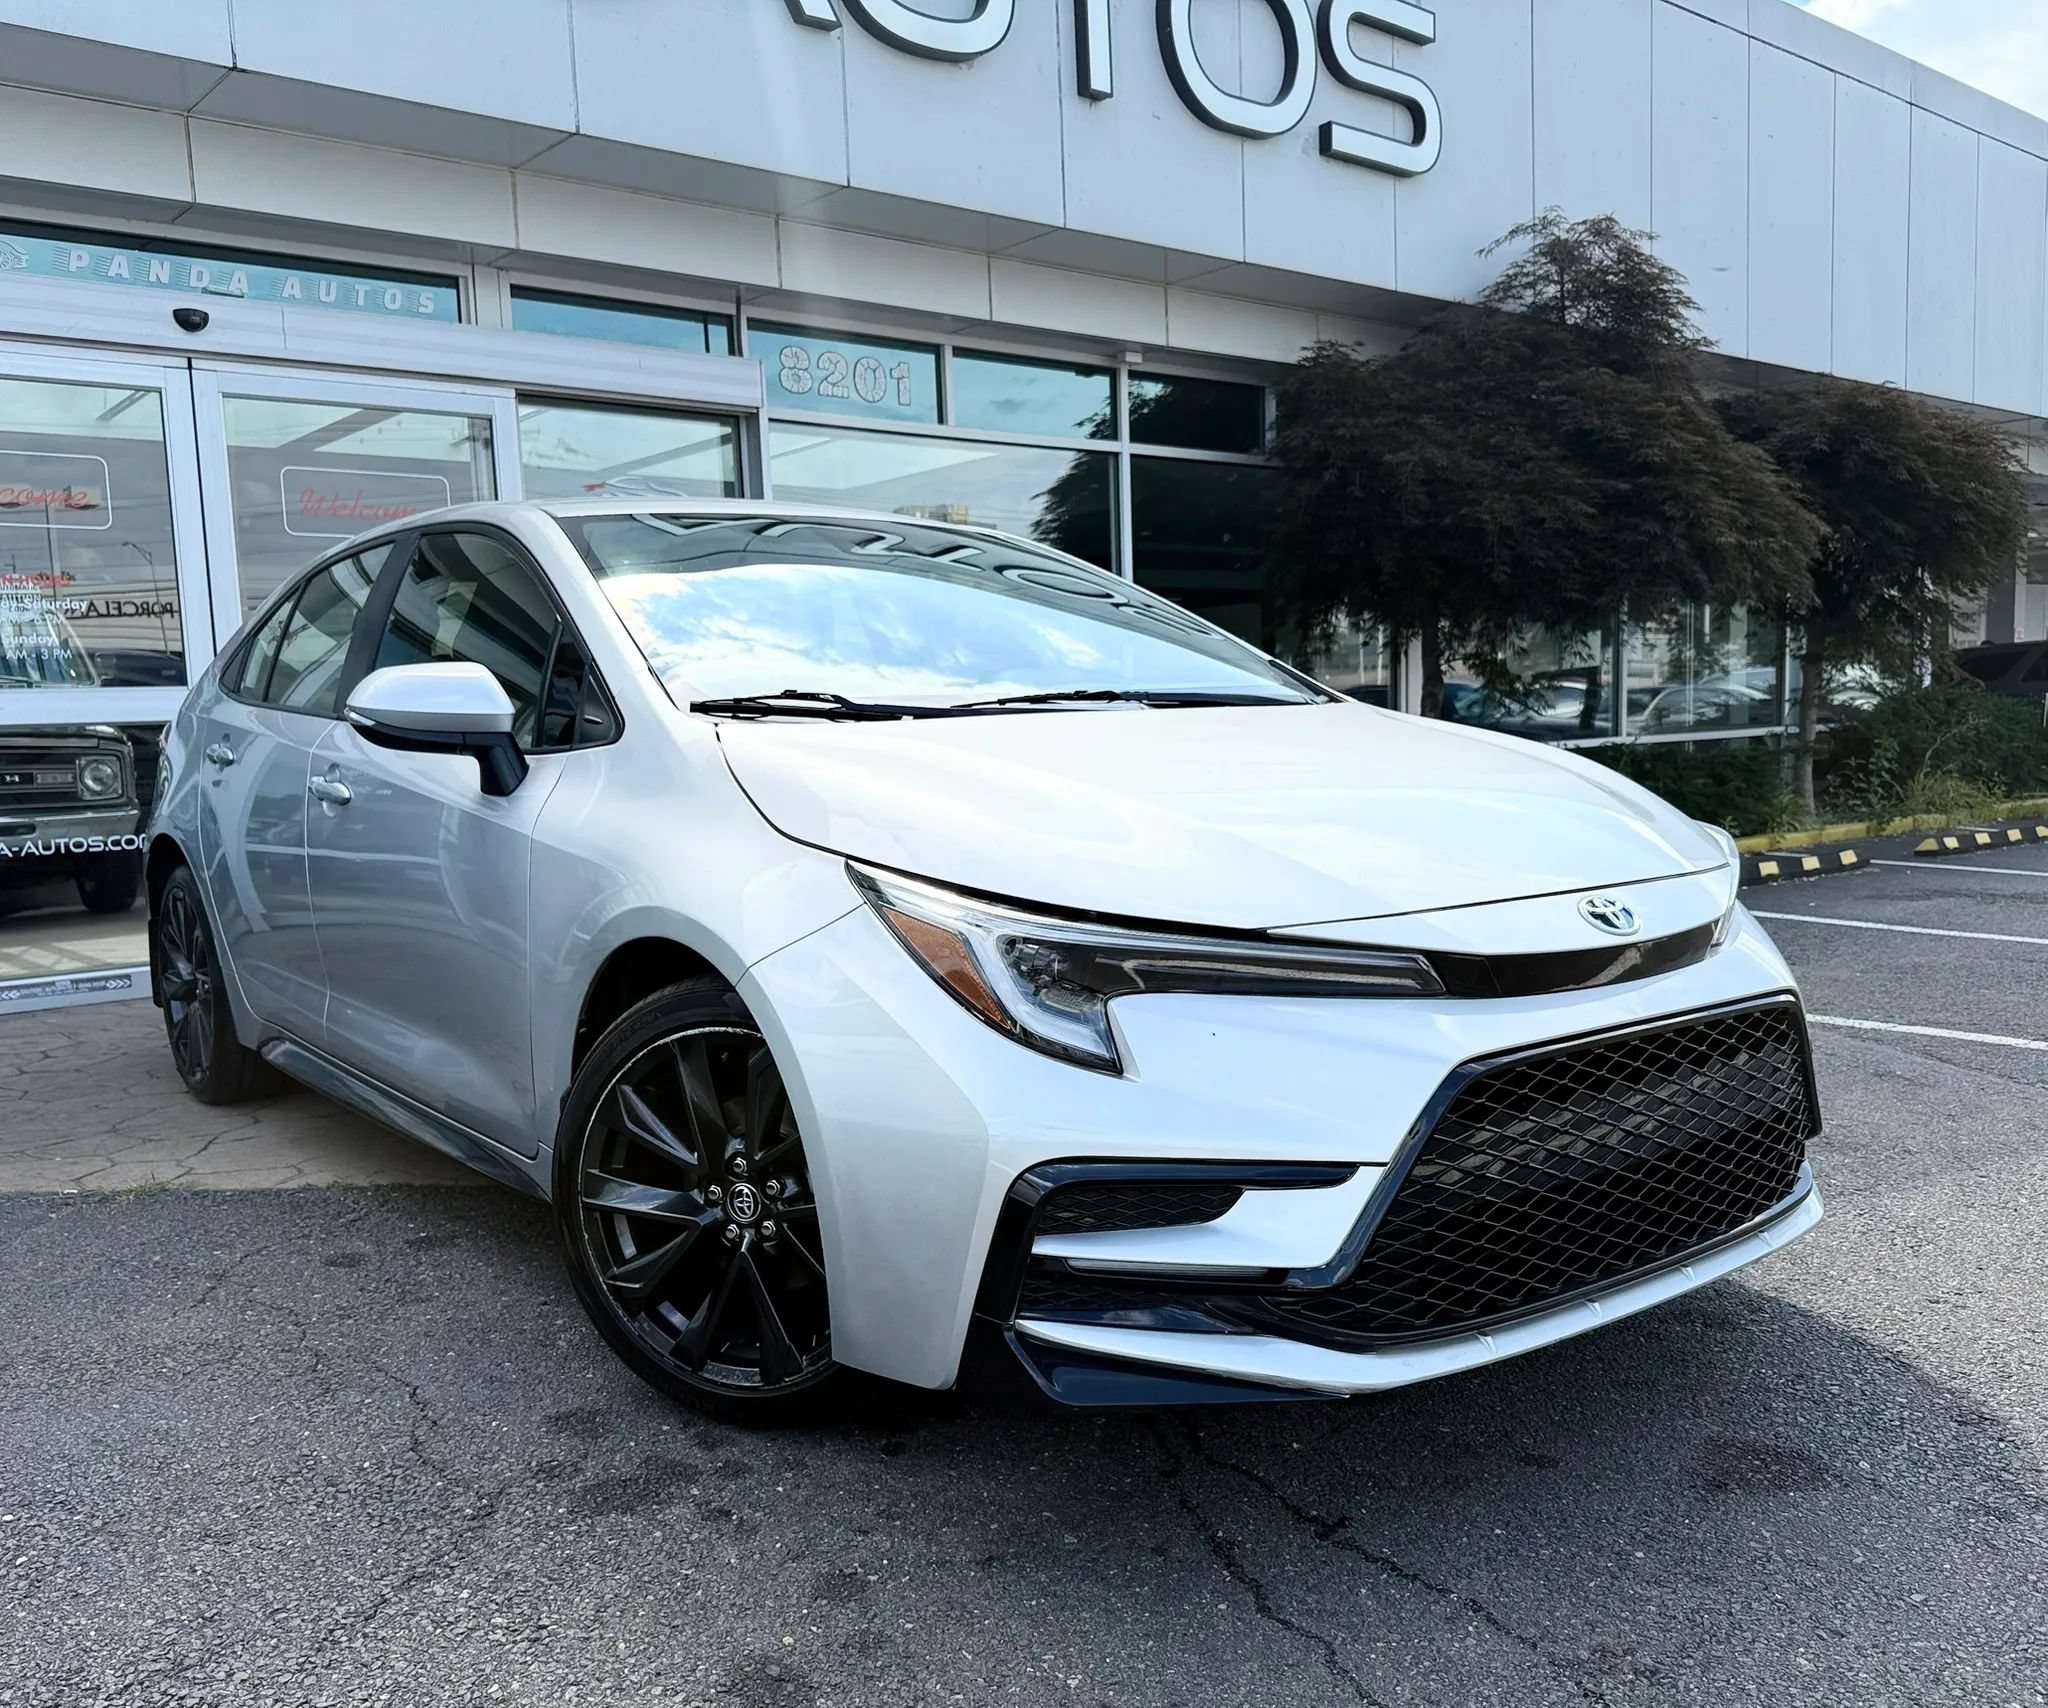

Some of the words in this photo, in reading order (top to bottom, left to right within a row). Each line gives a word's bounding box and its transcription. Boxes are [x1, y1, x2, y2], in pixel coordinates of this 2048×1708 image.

[68, 249, 249, 294] PANDA
[281, 276, 435, 314] AUTOS
[779, 345, 912, 406] 8201
[300, 487, 422, 520] Welcom
[1, 632, 55, 647] Sunday
[6, 648, 29, 660] AM
[41, 648, 49, 660] 3
[53, 648, 73, 660] PM
